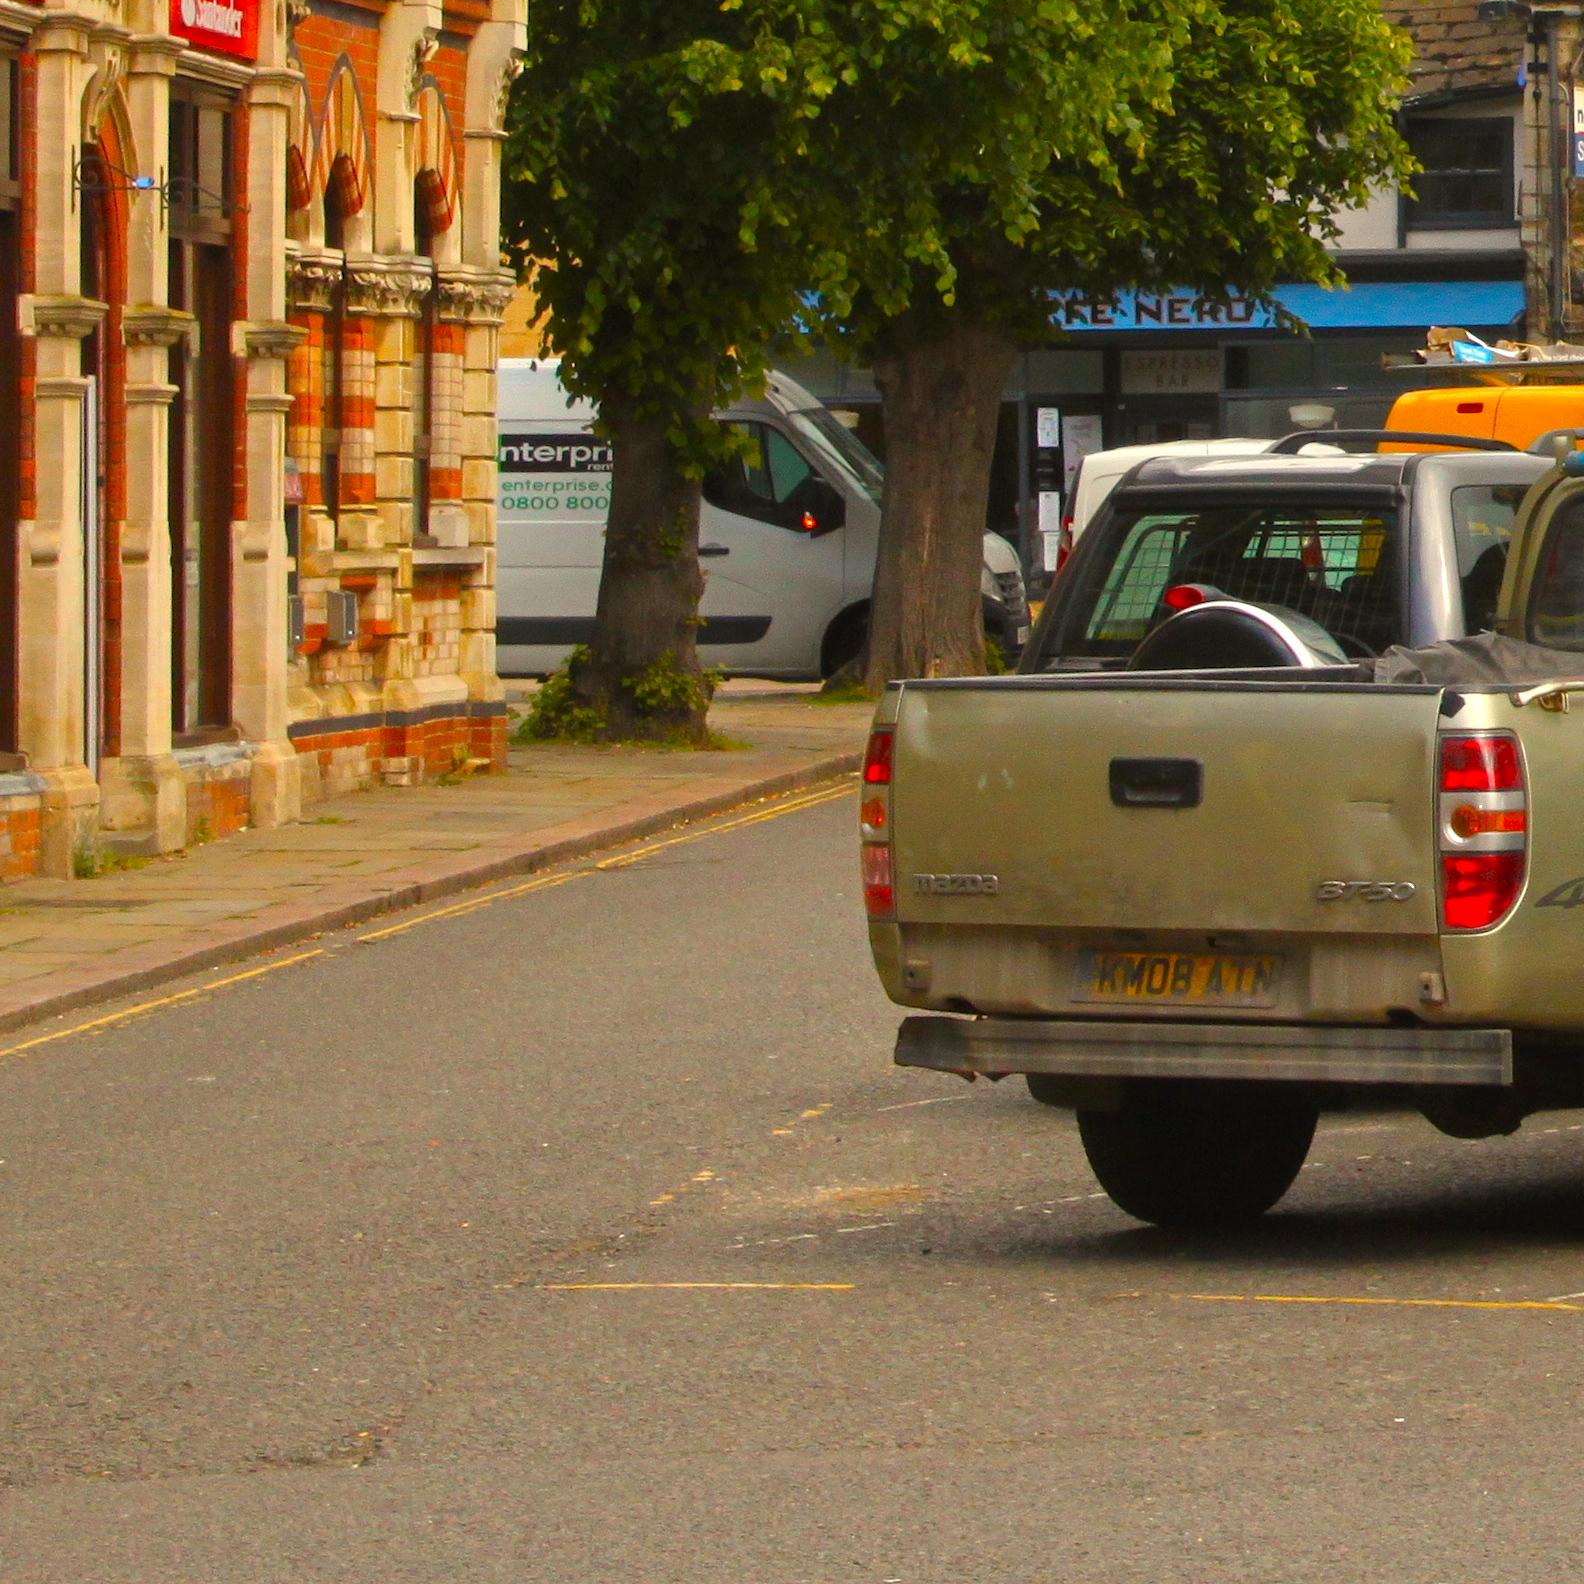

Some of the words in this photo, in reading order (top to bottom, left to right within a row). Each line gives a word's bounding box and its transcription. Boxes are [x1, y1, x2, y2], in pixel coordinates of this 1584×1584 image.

[499, 439, 613, 468] nterpri
[502, 496, 559, 511] 0800
[566, 496, 609, 511] 800
[1316, 880, 1417, 904] BT-50
